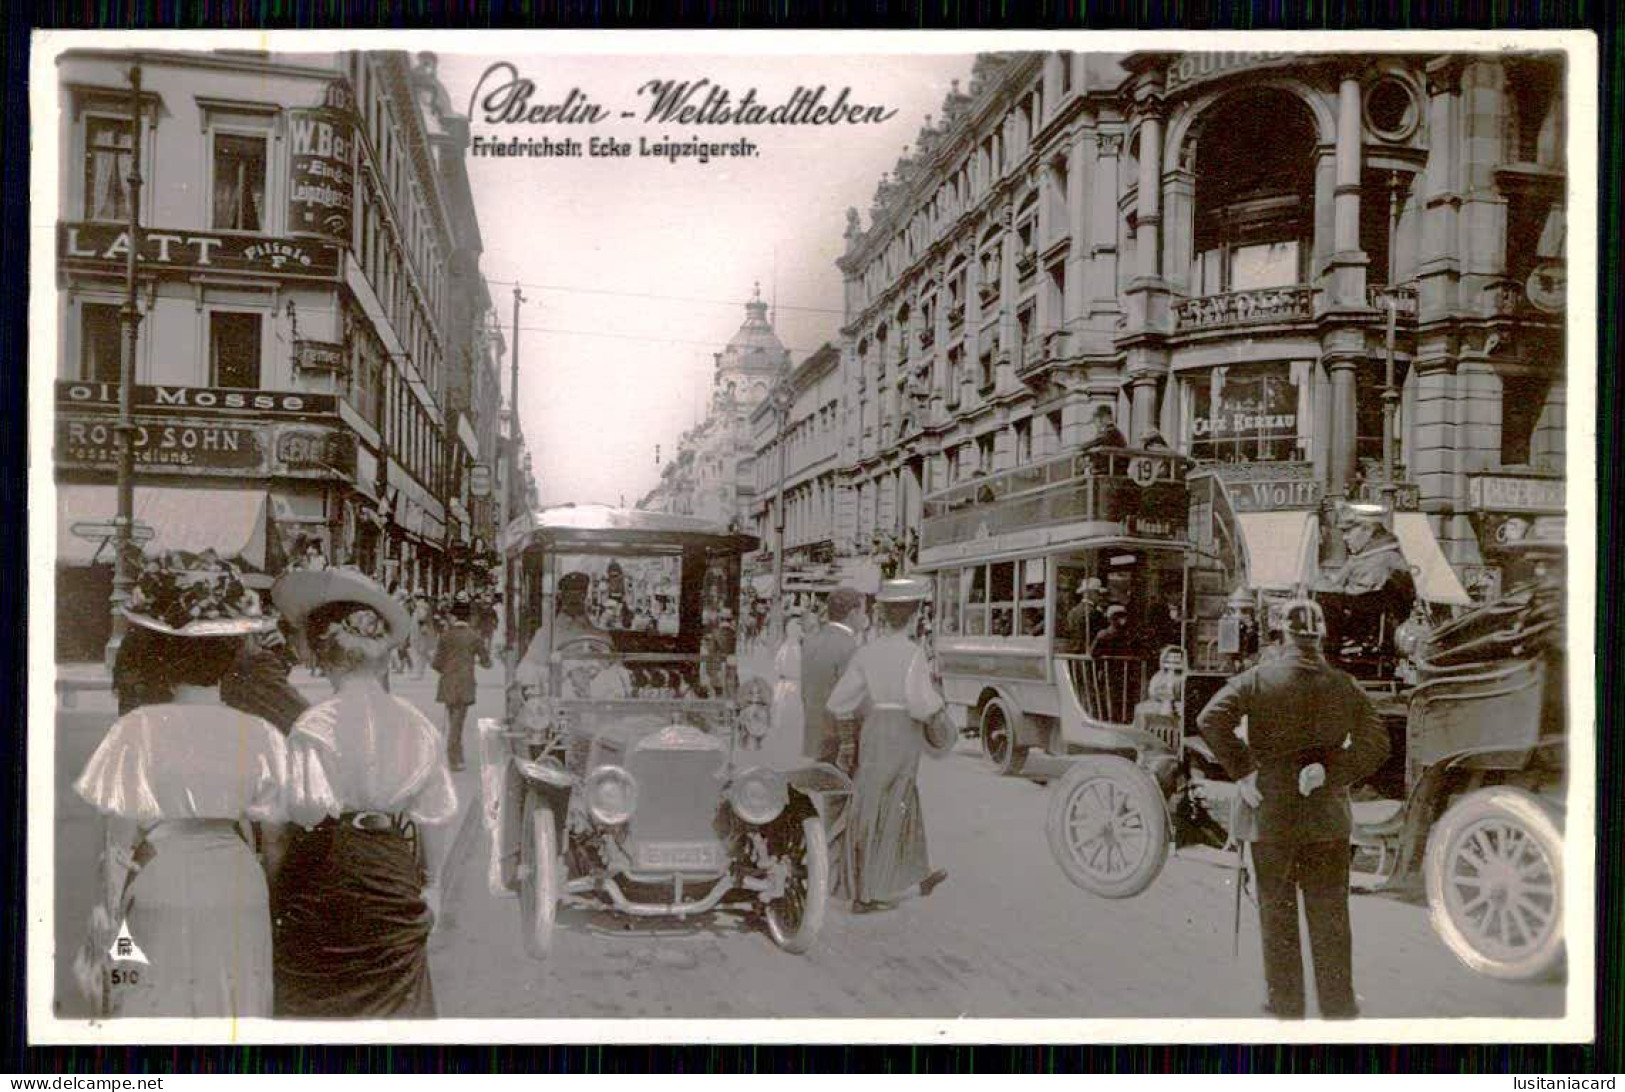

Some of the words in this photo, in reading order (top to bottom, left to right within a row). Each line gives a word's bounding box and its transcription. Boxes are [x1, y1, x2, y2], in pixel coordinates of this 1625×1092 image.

[66, 227, 223, 266] LATT
[154, 386, 304, 411] Mosse
[160, 427, 240, 451] SOHN
[1137, 460, 1152, 481] 19
[1251, 482, 1319, 506] Wolff
